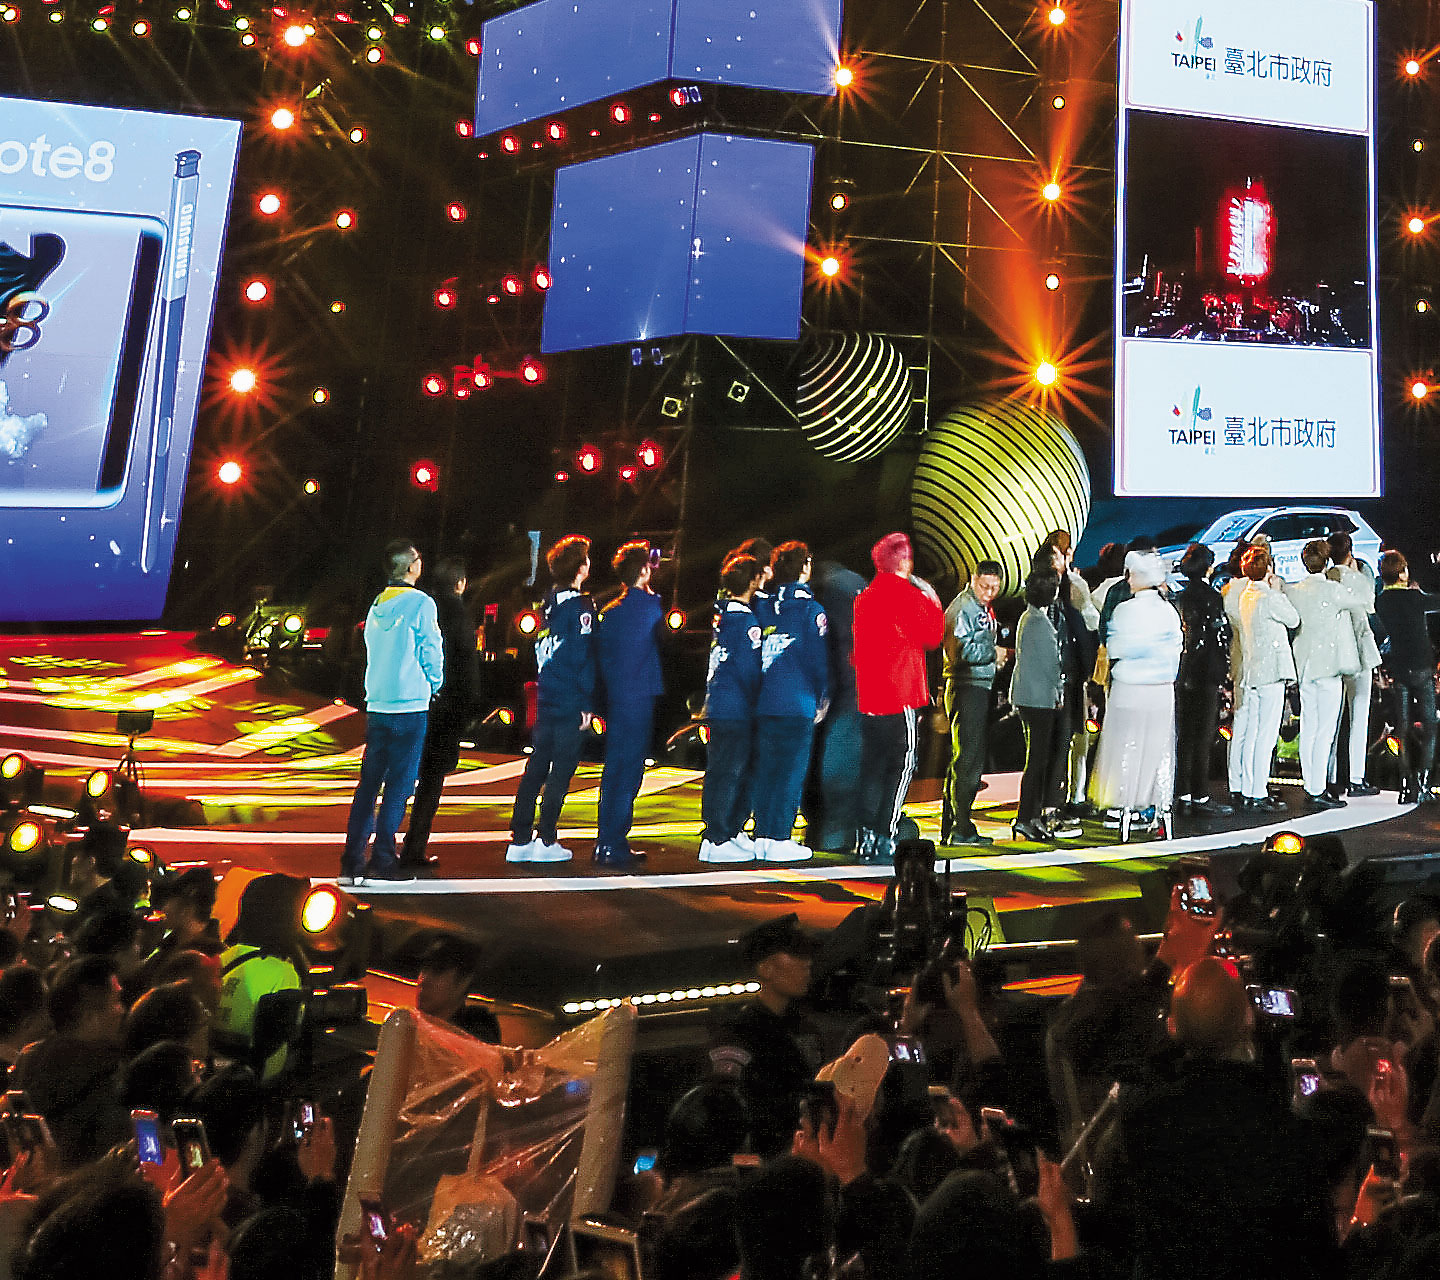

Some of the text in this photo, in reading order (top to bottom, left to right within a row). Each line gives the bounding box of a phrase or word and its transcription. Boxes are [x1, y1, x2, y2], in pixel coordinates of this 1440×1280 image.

[1171, 47, 1332, 87] TAIPEI 臺北市政府
[175, 203, 193, 279] SAMSUNG
[1168, 416, 1337, 448] TAIPEI 臺北市政府
